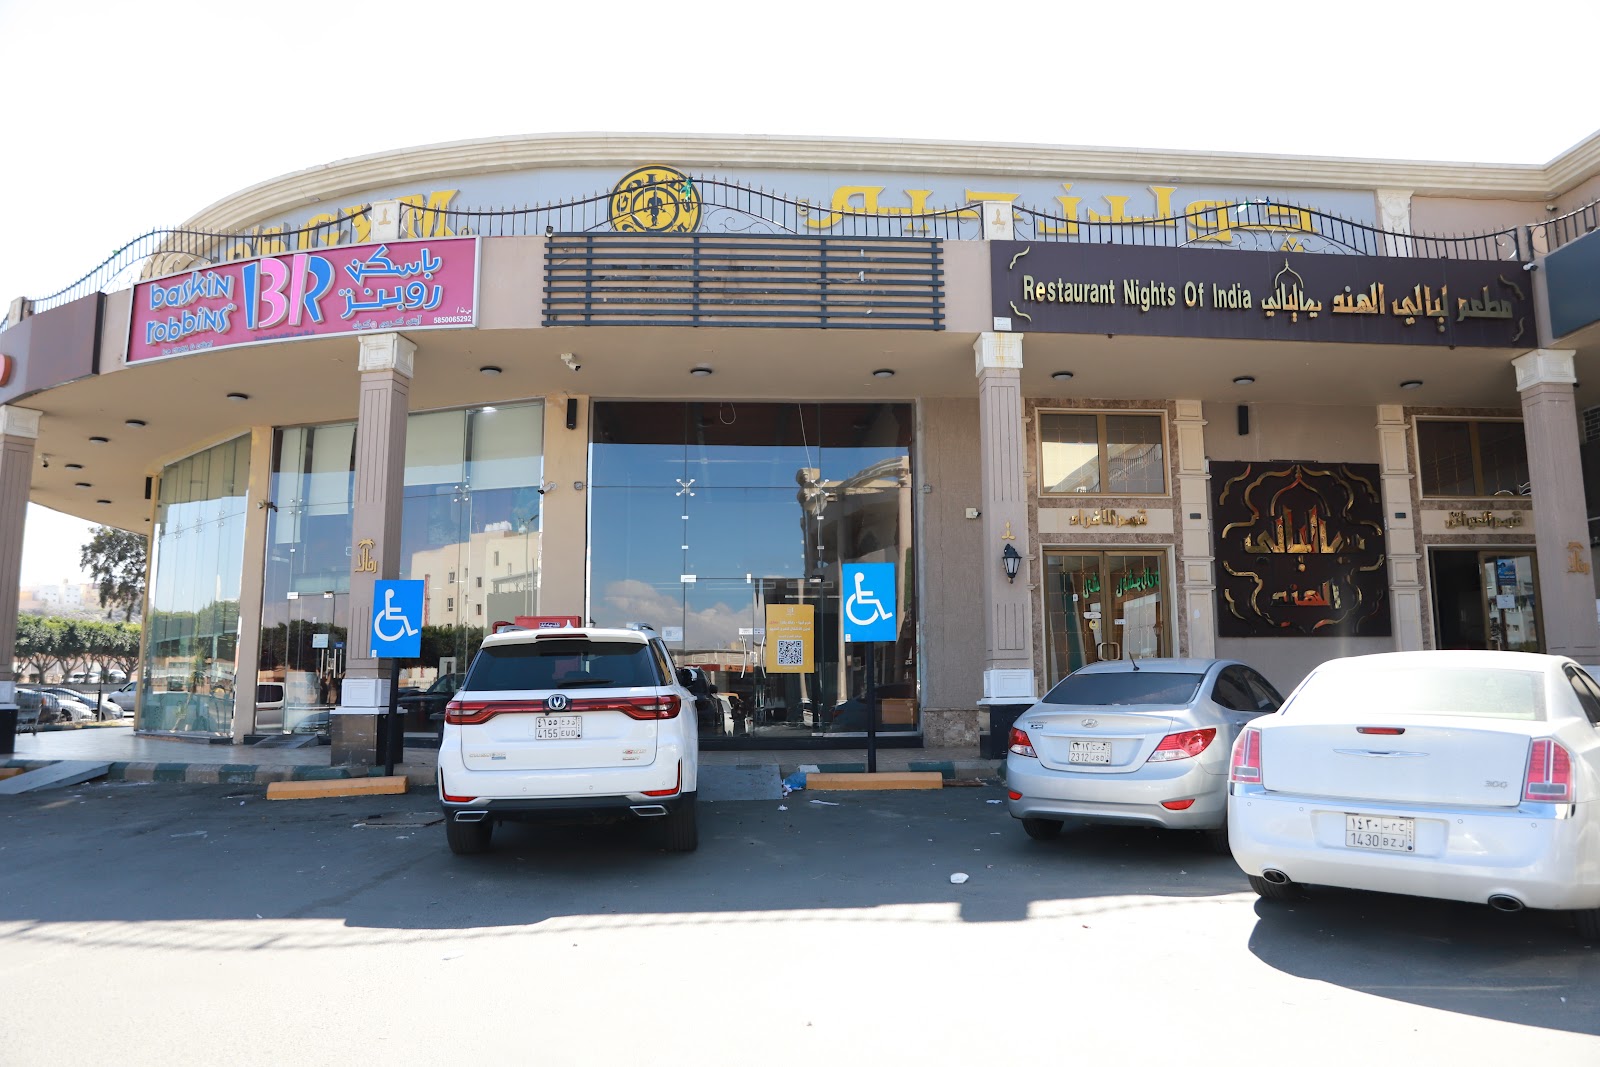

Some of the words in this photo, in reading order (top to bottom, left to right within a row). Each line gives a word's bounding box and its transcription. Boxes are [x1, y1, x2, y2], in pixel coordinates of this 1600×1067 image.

[344, 244, 443, 287] باسكن
[1023, 275, 1115, 304] Restaurant
[1123, 279, 1176, 312] Nights
[1184, 280, 1204, 307] Of
[1212, 282, 1252, 309] India
[1332, 281, 1385, 315] الهند
[1392, 283, 1449, 333] ليالي
[1456, 284, 1513, 322] مطعم
[537, 728, 558, 738] 4155
[1070, 752, 1090, 762] 2312
[1350, 832, 1380, 847] 1430
[1383, 838, 1405, 848] BZJ
